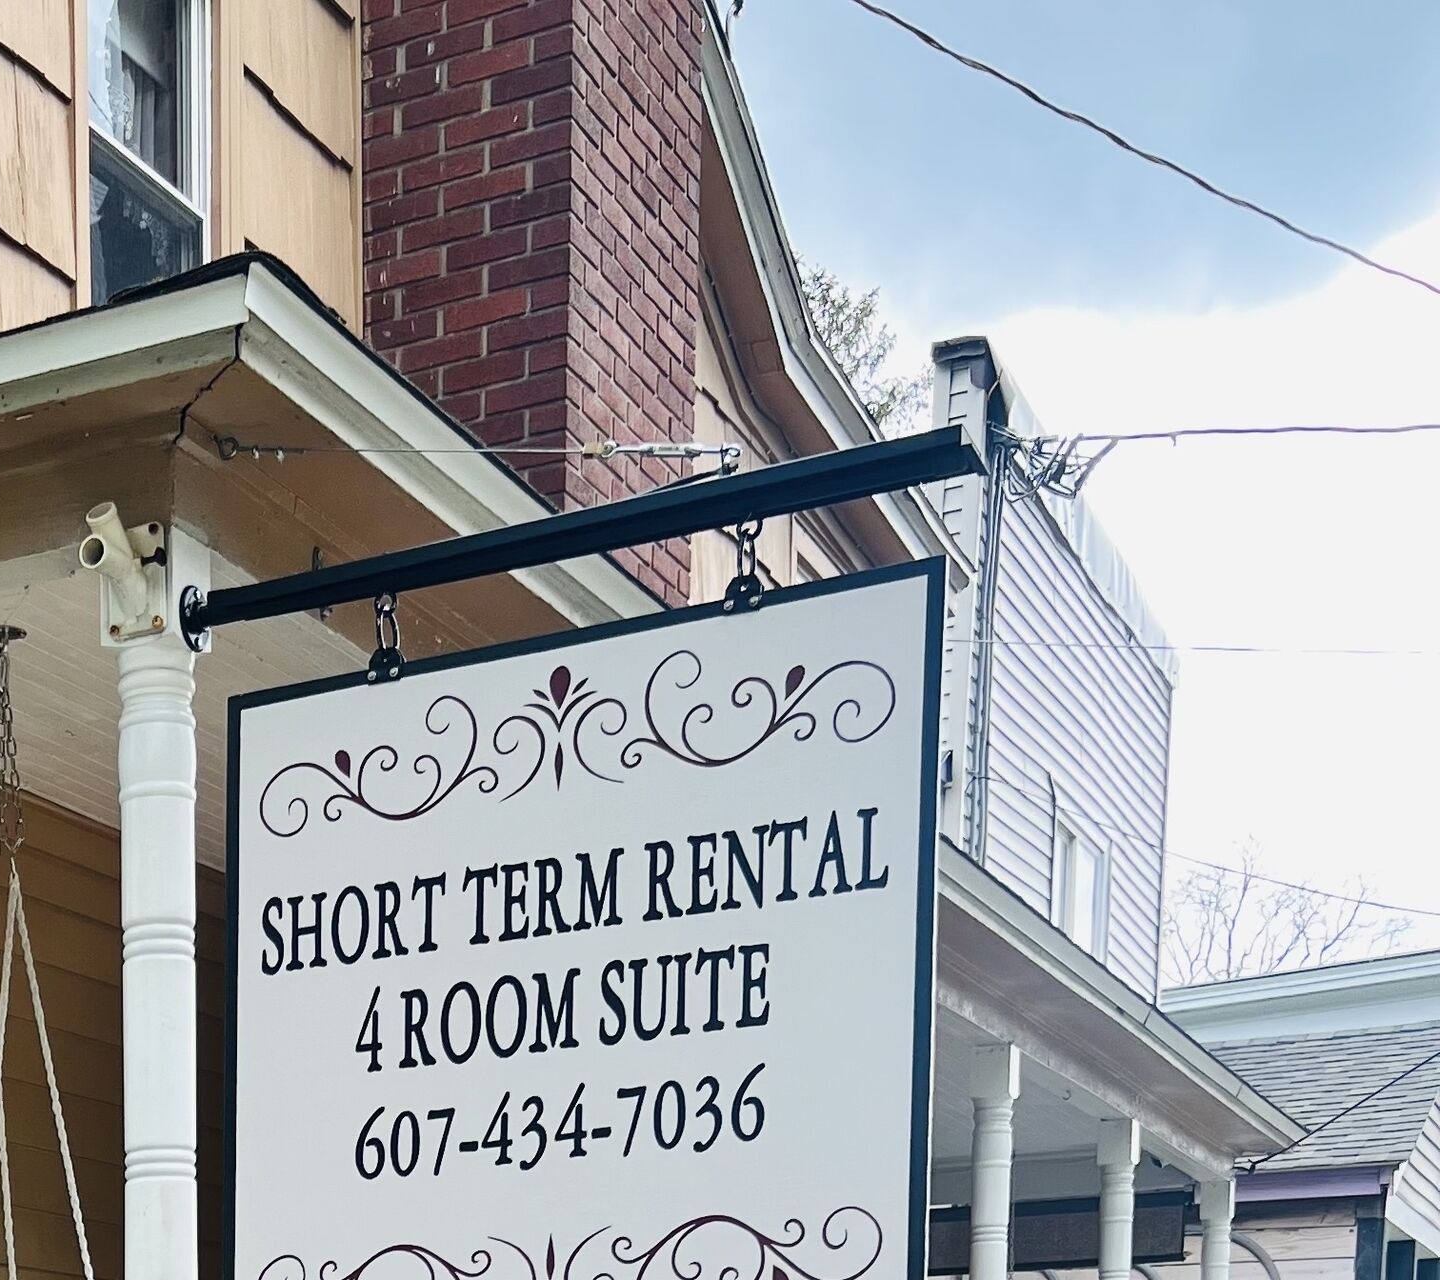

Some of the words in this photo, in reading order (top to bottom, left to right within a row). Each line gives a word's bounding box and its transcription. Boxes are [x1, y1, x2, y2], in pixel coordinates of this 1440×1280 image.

[262, 872, 447, 976] SHORT
[463, 848, 625, 946] TERM
[643, 807, 889, 922] RENTAL
[356, 986, 383, 1073] 4
[399, 968, 581, 1069] ROOM
[599, 944, 771, 1046] SUITE
[356, 1063, 766, 1180] 607-434-7036
